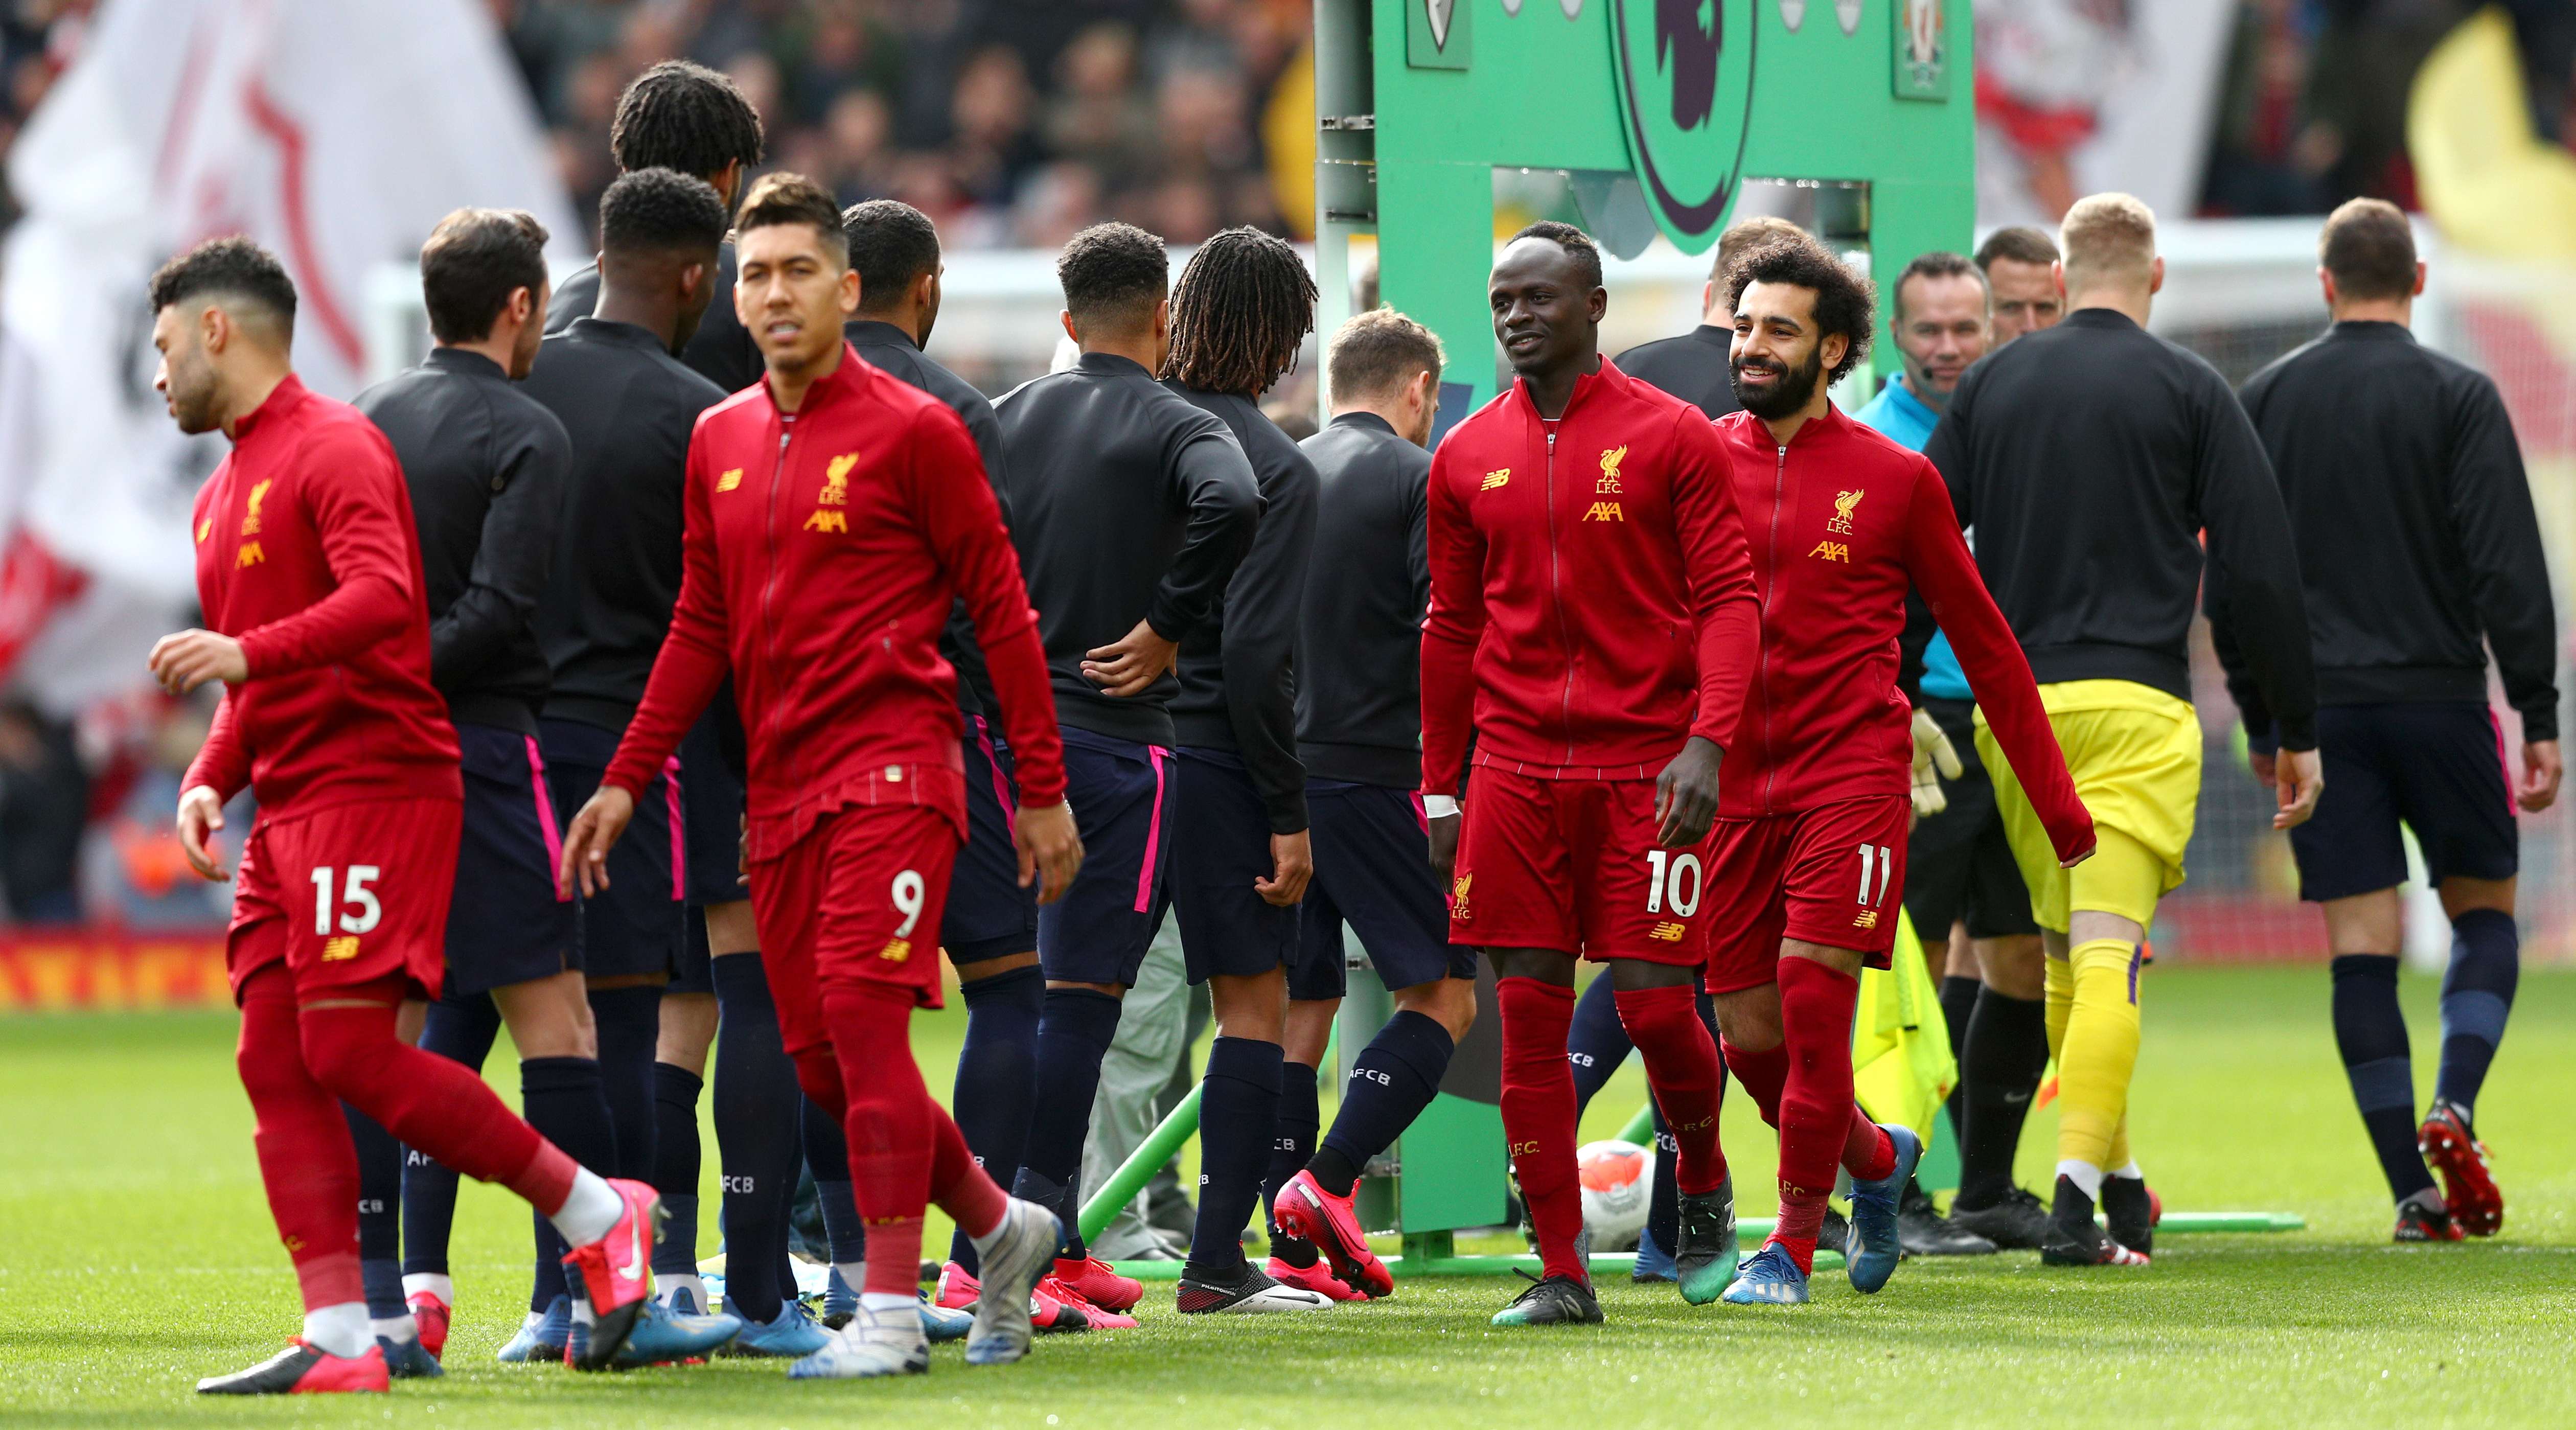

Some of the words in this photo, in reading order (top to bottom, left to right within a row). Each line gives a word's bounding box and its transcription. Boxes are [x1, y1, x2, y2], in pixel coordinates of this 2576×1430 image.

[1596, 482, 1623, 494] L.F.C.
[1582, 501, 1624, 521] AXA
[1826, 521, 1853, 536] L.F.C.
[1807, 540, 1849, 563] AXA
[1646, 850, 1701, 917] 10
[1857, 843, 1891, 908] 11
[310, 864, 382, 936] 15
[891, 869, 926, 939] 9
[1452, 909, 1472, 919] L.F.C.
[1348, 1068, 1391, 1087] AFCB
[1653, 1130, 1678, 1153] FCB
[720, 1175, 754, 1194] FCB
